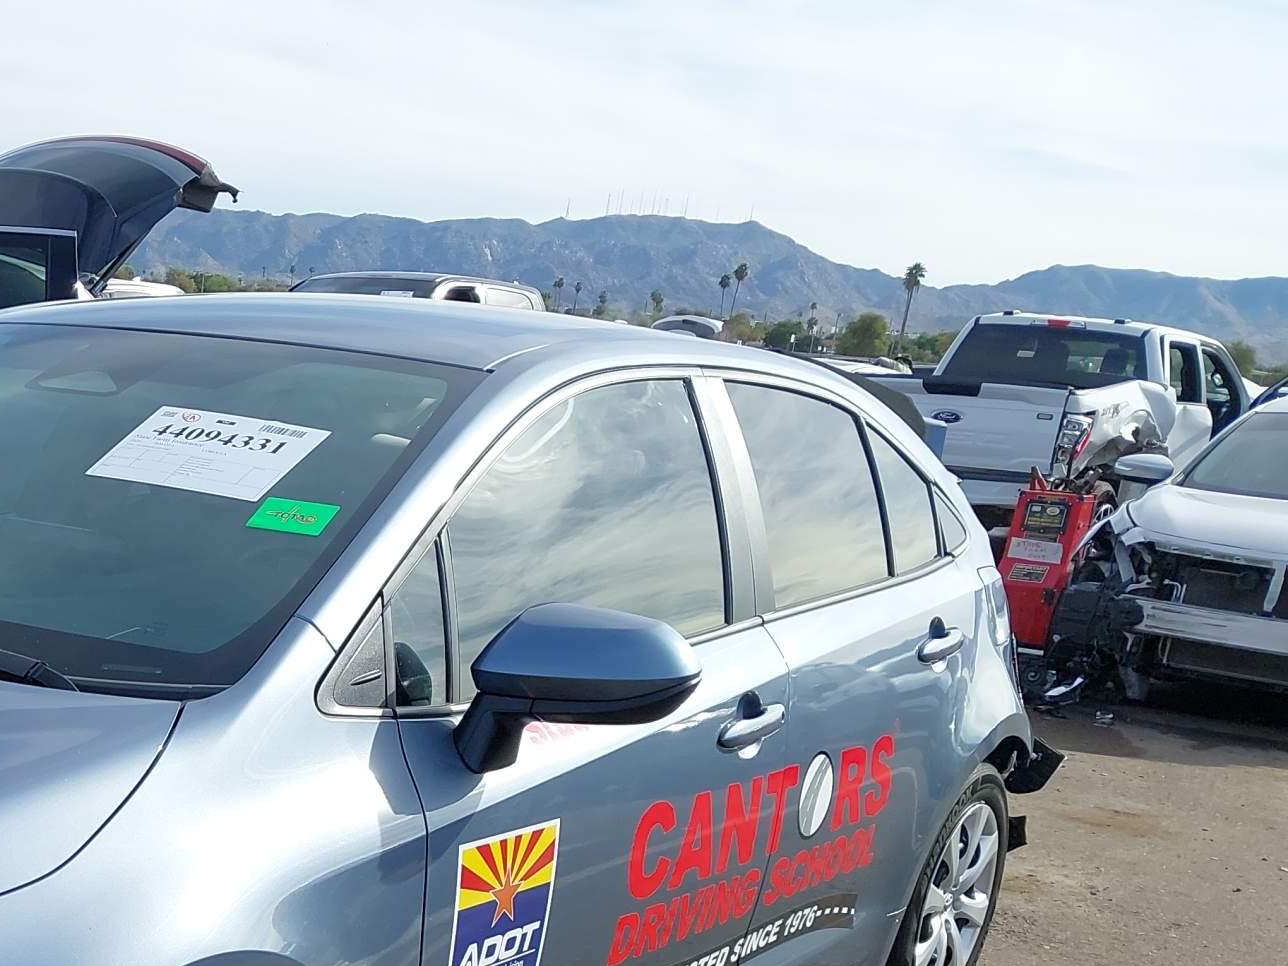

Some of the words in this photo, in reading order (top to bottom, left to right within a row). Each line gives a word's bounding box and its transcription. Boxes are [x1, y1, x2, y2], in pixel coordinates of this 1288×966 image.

[152, 423, 288, 455] 44094331
[627, 734, 896, 900] CANTORS
[764, 823, 877, 906] SCHOOL
[730, 920, 780, 963] SINCE
[784, 904, 817, 936] 1976
